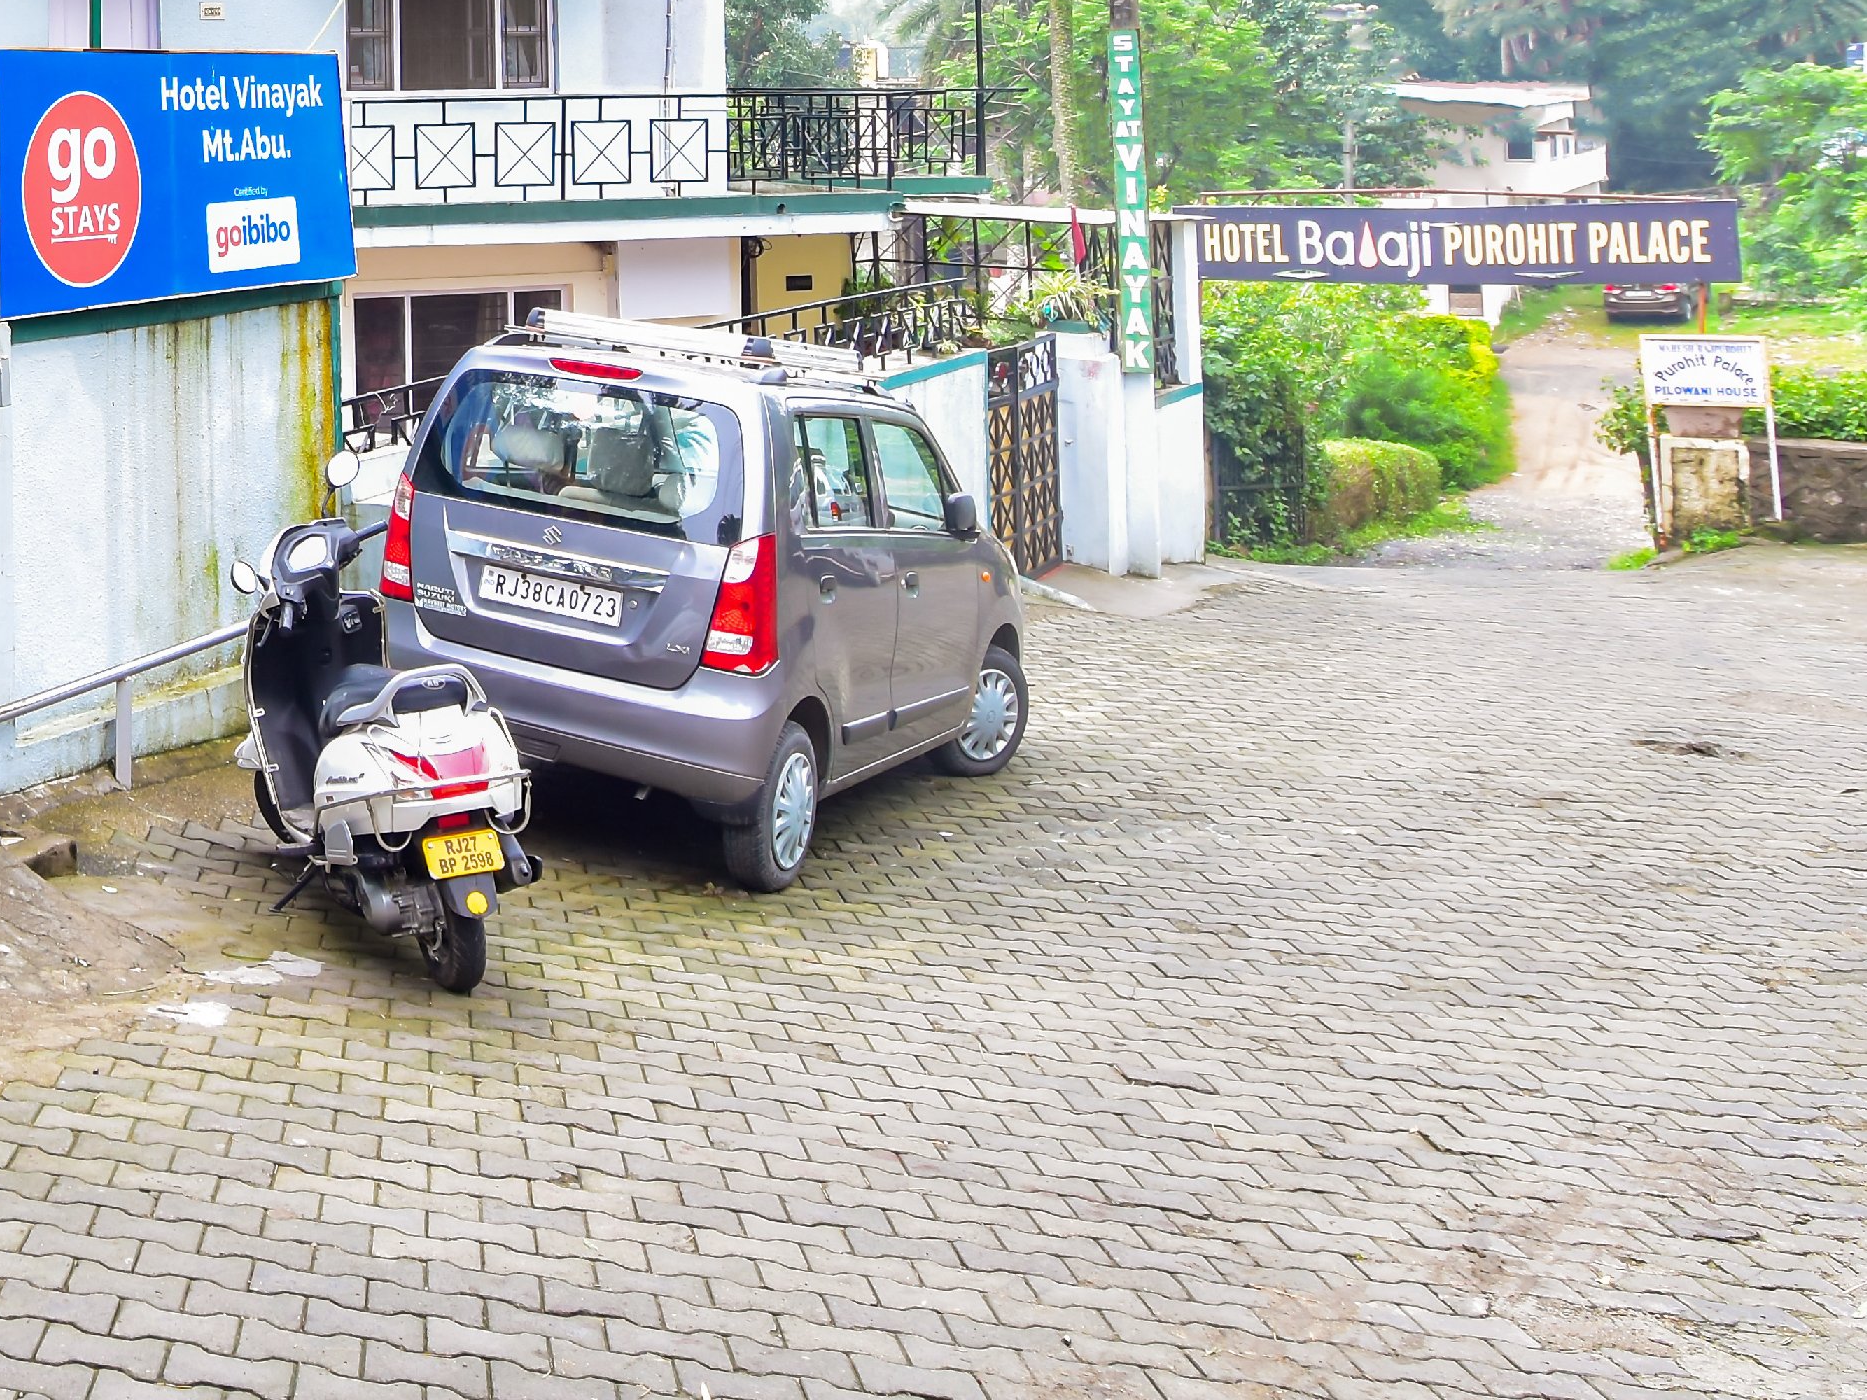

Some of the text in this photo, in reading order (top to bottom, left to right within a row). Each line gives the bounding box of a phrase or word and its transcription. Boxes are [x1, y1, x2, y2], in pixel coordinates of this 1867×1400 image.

[1112, 34, 1136, 118] STAY
[160, 74, 324, 118] Hotel Vinayak
[202, 126, 292, 163] Mt.Abu.
[1115, 119, 1141, 138] AT
[47, 126, 117, 203] go
[51, 202, 121, 237] STAYS
[216, 213, 291, 258] goibibo
[1115, 143, 1151, 370] VINAYAK
[1203, 222, 1290, 264] HOTEL
[1443, 220, 1578, 265] PUROHIT
[1589, 219, 1712, 264] PALACE
[1654, 353, 1754, 386] Purohit Palace
[1717, 387, 1759, 398] HOUSE
[416, 582, 455, 596] MARUTI
[416, 589, 455, 604] SUZUKI
[495, 573, 617, 618] RJ38CA0723
[439, 851, 494, 875] BP 2598
[444, 836, 477, 855] RJ27
